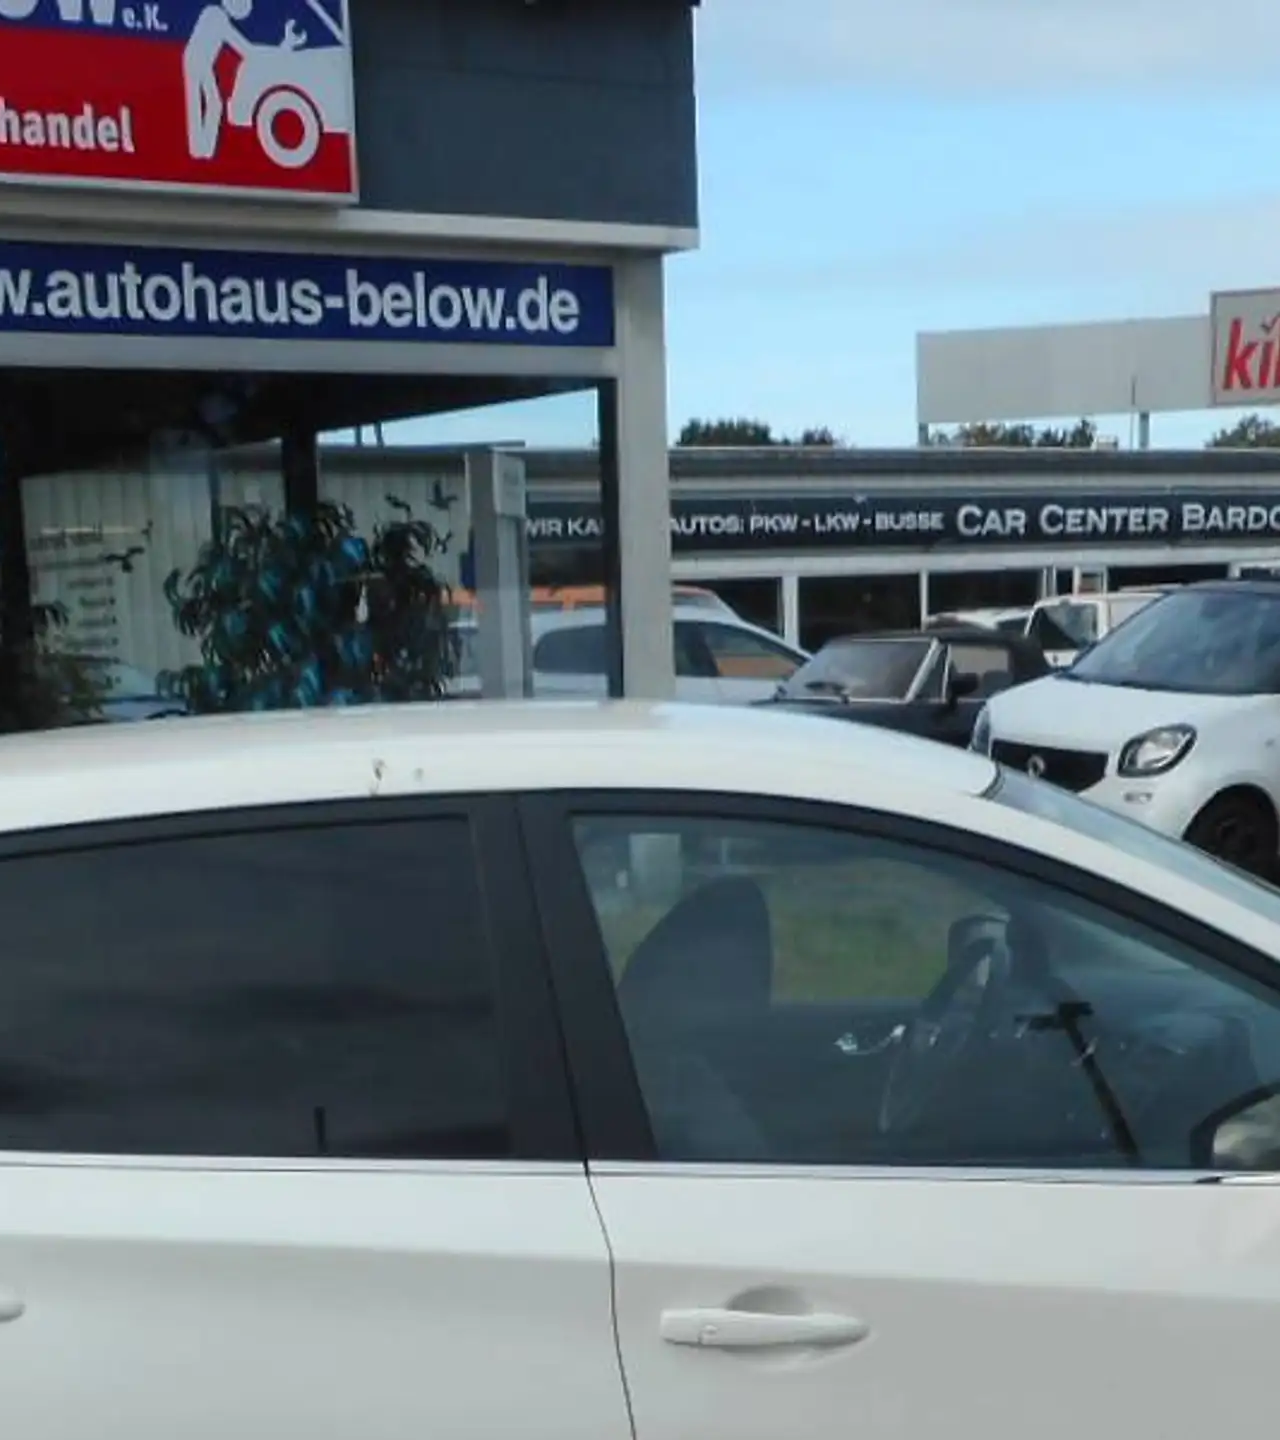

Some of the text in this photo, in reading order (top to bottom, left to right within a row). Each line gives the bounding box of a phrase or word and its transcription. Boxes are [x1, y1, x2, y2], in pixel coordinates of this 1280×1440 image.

[121, 4, 168, 31] e.K.
[750, 513, 799, 534] PKW
[814, 512, 861, 533] LKW
[874, 511, 944, 531] BUSSE
[956, 504, 1027, 536] CAR
[1039, 503, 1169, 534] CENTER
